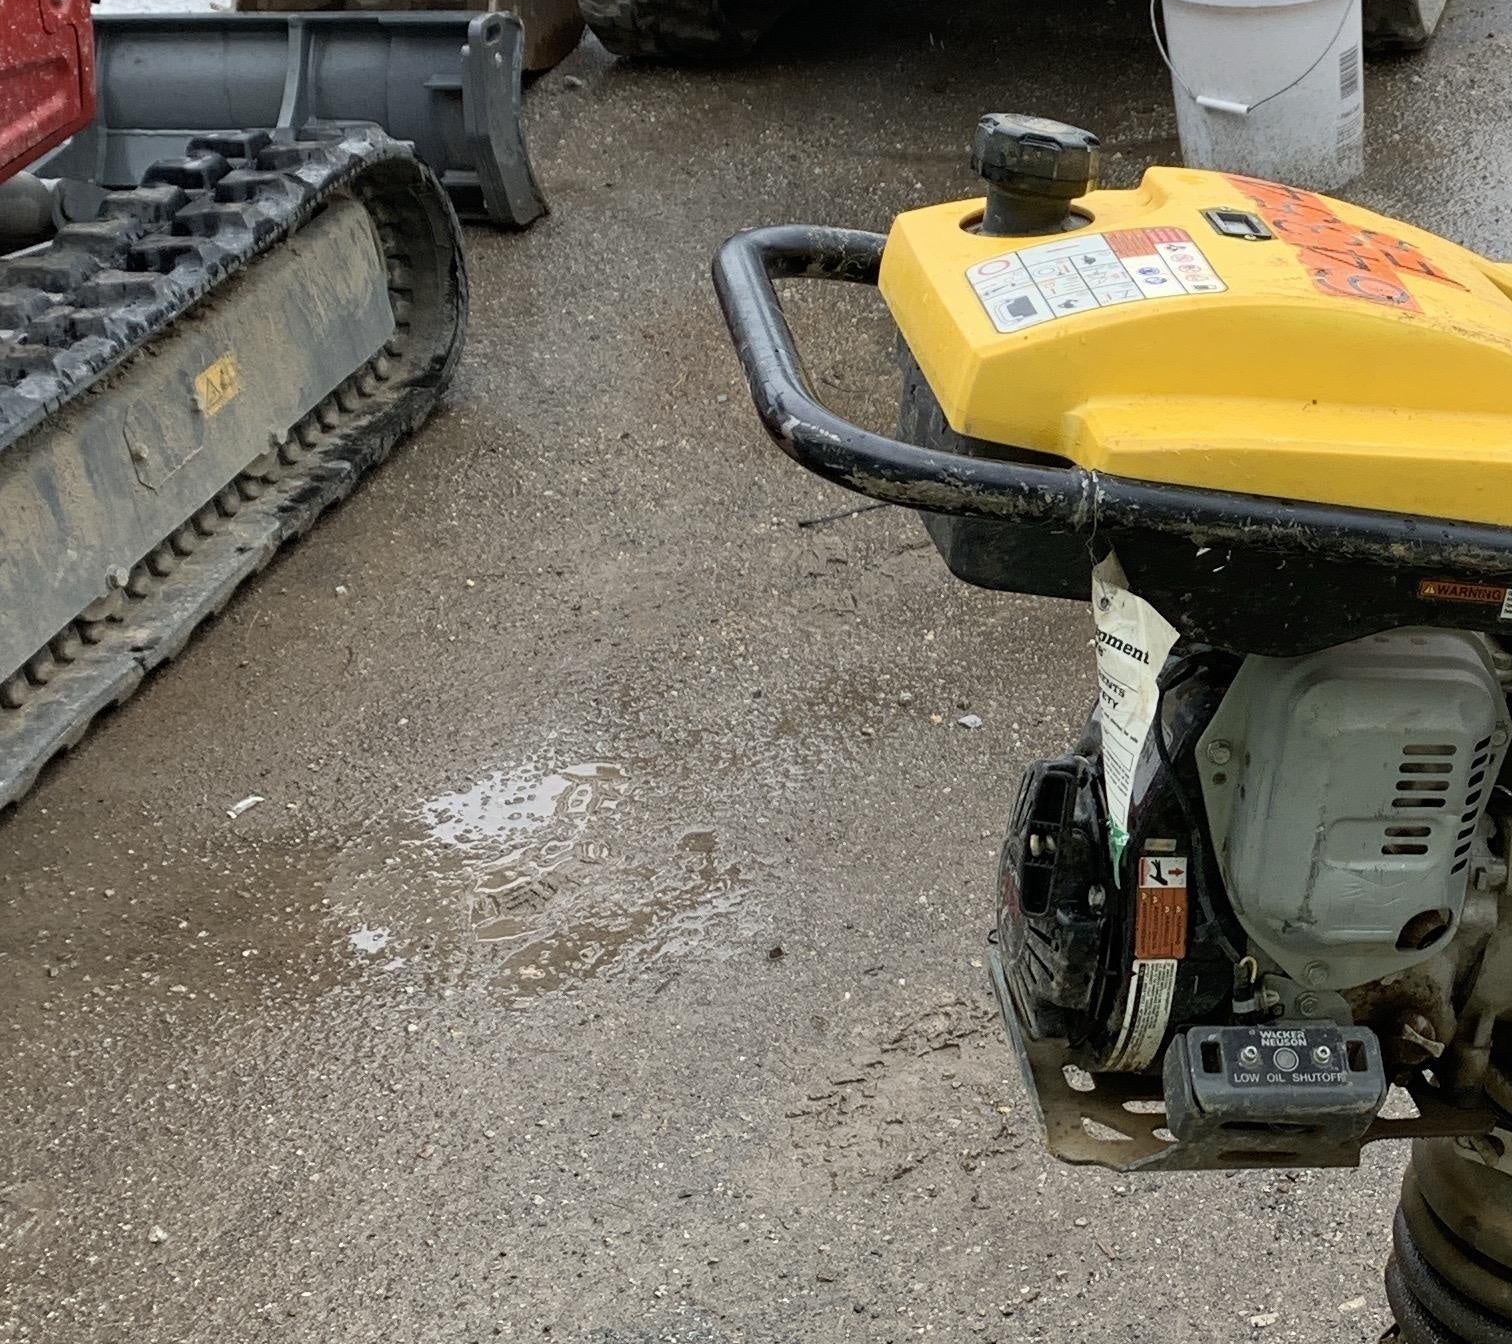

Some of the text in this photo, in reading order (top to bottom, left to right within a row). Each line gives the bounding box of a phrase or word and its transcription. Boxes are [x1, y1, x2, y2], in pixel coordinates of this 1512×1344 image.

[1437, 583, 1501, 600] WARNING
[1096, 626, 1150, 665] pment
[1260, 1030, 1305, 1039] WACKER
[1261, 1038, 1307, 1047] NEUSON
[1233, 1071, 1347, 1083] LOW OIL SHUTOFF
